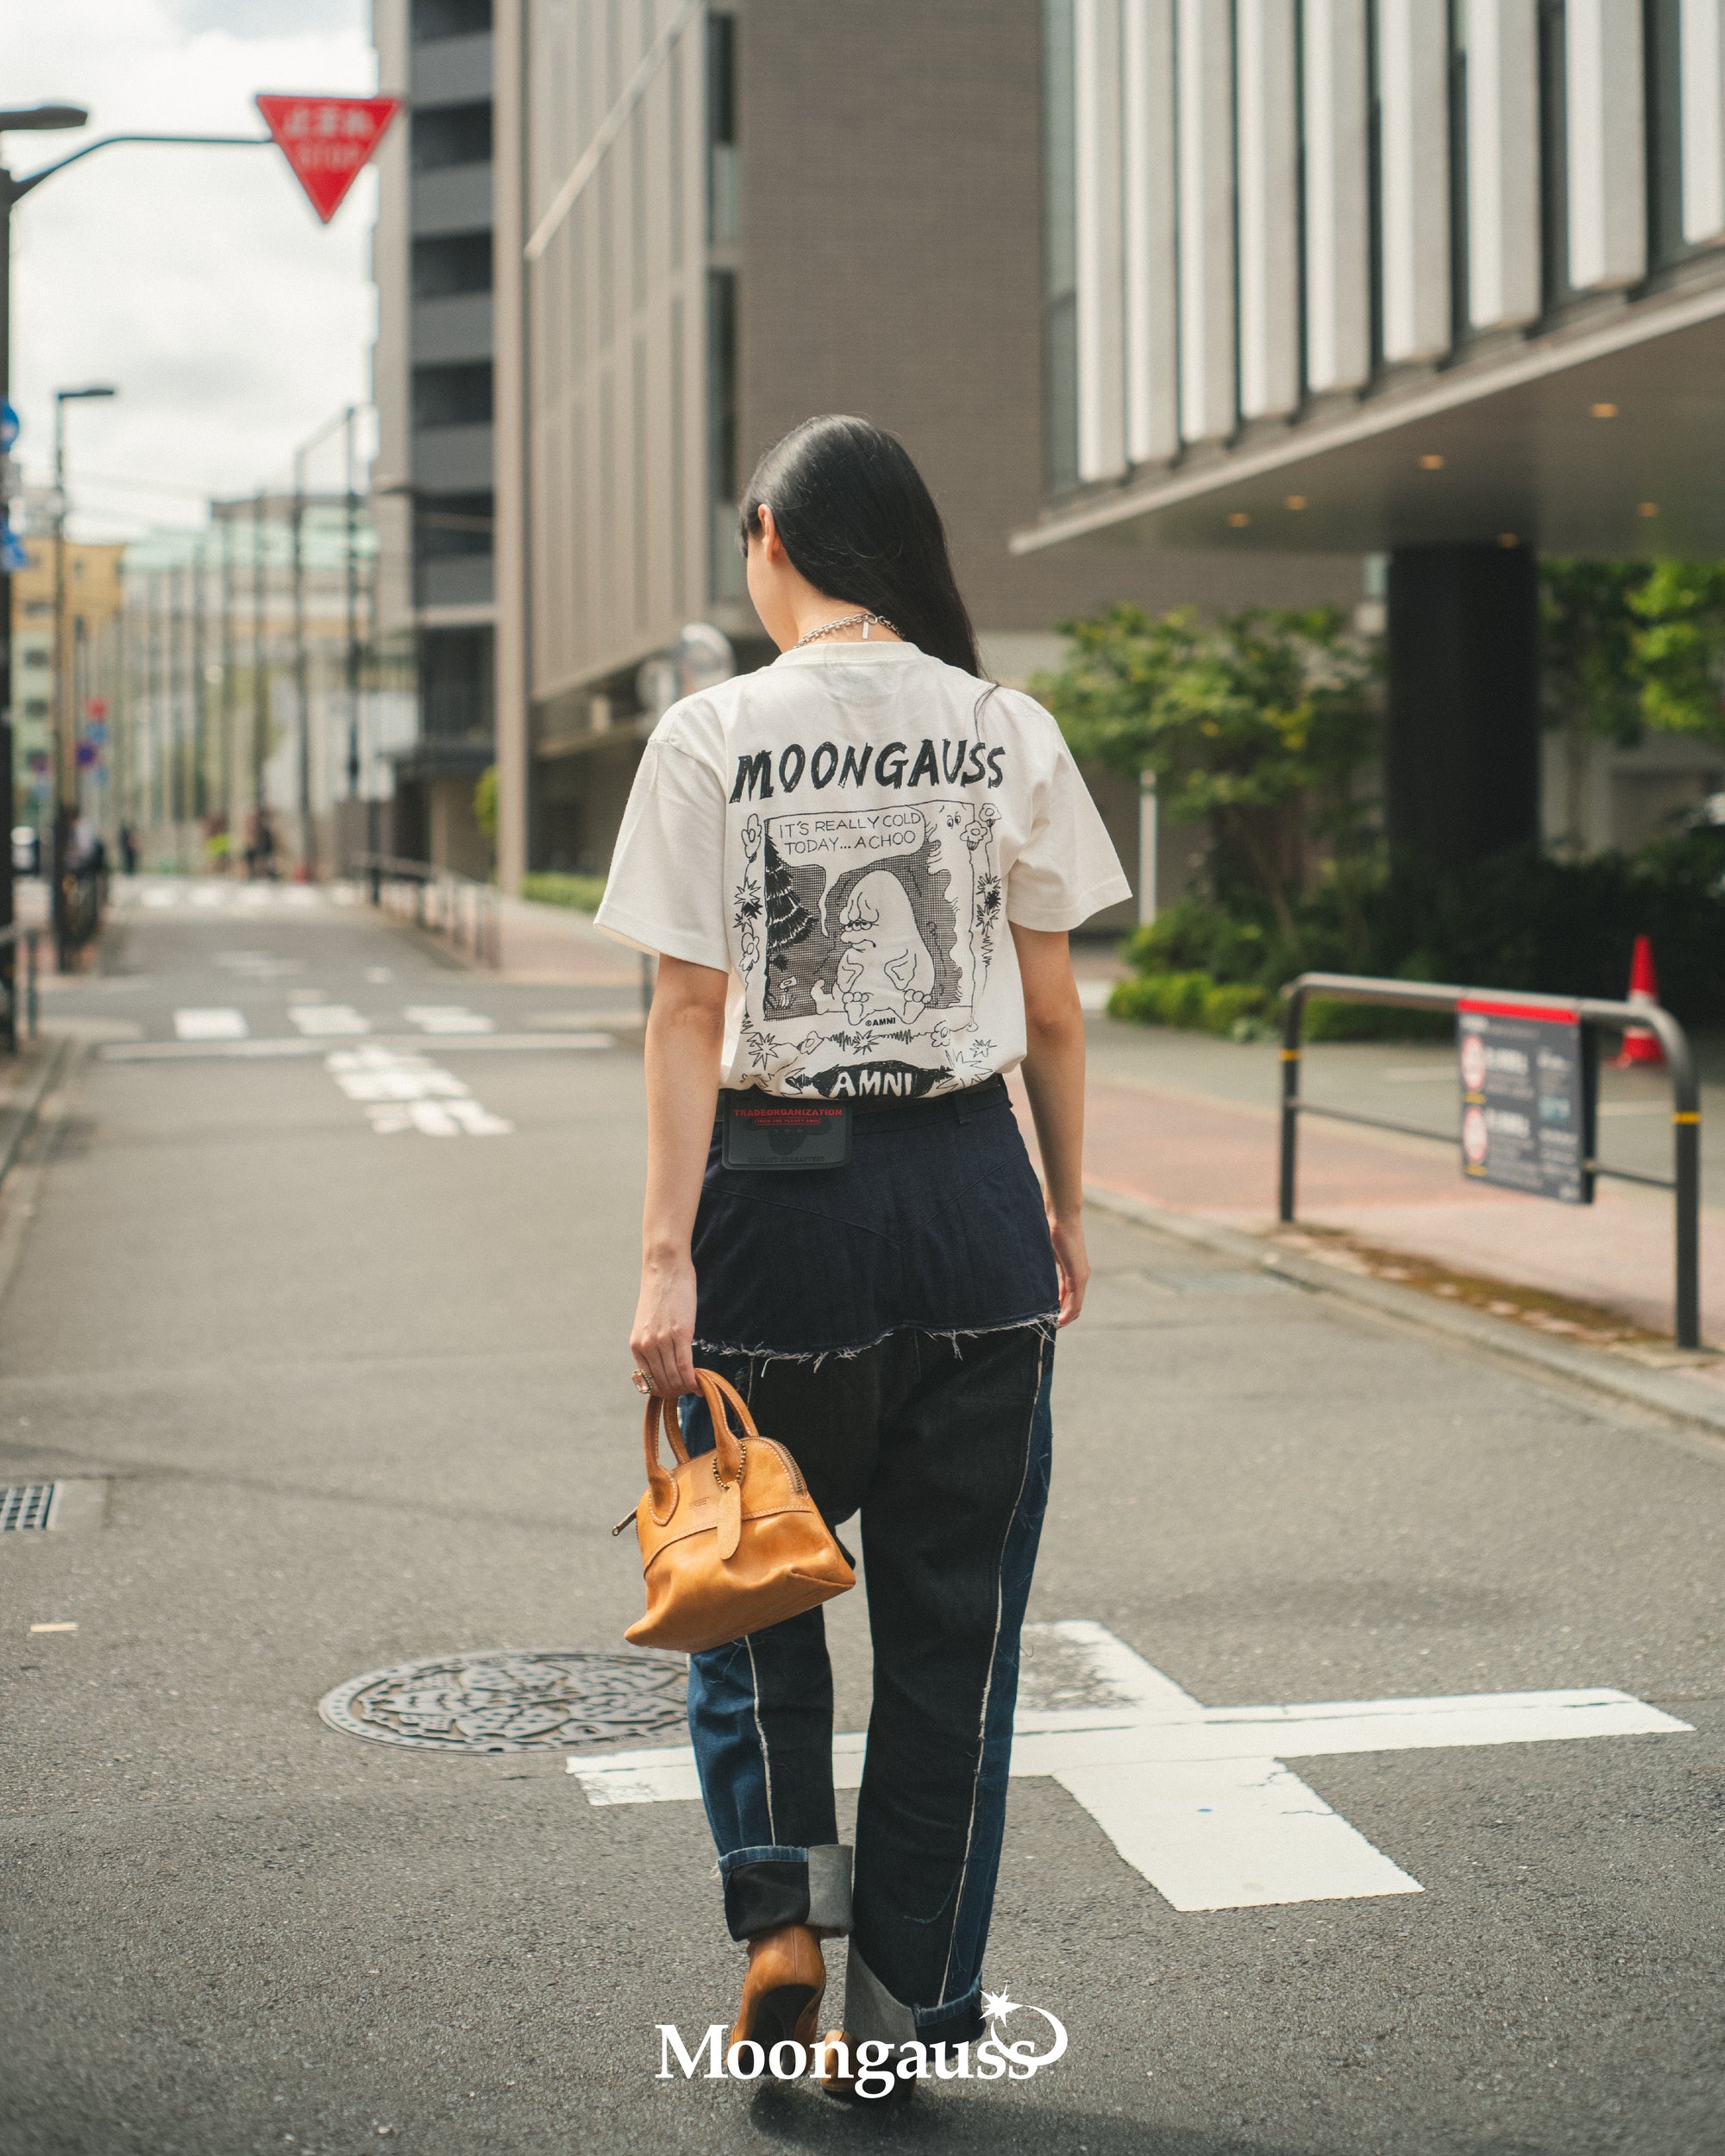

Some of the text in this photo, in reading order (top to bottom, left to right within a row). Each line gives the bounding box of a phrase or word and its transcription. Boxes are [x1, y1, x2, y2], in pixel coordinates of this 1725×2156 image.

[729, 738, 1006, 804] MOONGAUSS
[779, 812, 921, 838] IT'S REALLY COLD
[828, 1069, 913, 1098] AMNI
[734, 1108, 843, 1117] TRADEORGANIZATION
